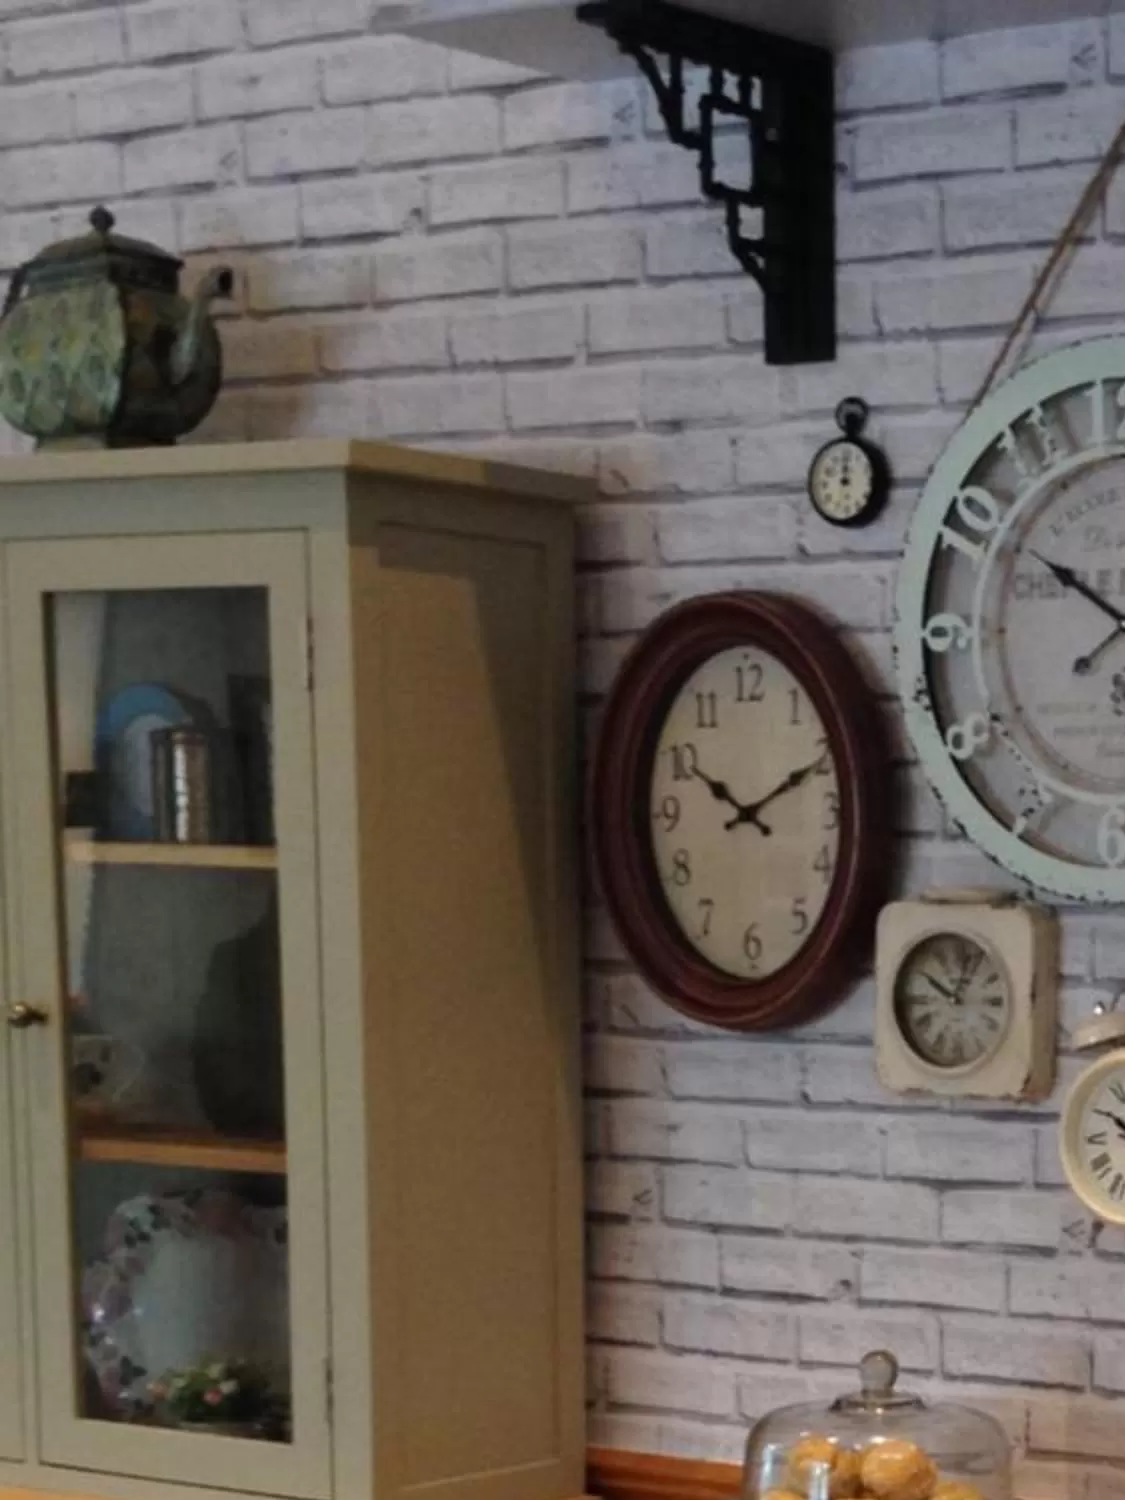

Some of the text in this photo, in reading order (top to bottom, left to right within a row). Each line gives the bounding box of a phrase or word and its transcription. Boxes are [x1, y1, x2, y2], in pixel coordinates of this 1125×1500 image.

[941, 486, 1001, 564] 10
[921, 613, 974, 653] 9
[734, 664, 764, 702] 12
[697, 693, 718, 728] 11
[789, 689, 801, 725] 1
[945, 711, 991, 760] 8
[669, 744, 697, 781] 10
[815, 737, 832, 776] 2
[663, 795, 680, 832] 9
[823, 793, 840, 829] 3
[673, 849, 690, 886] 8
[814, 846, 832, 883] 4
[698, 899, 713, 936] 7
[792, 899, 808, 934] 5
[744, 923, 762, 960] 6
